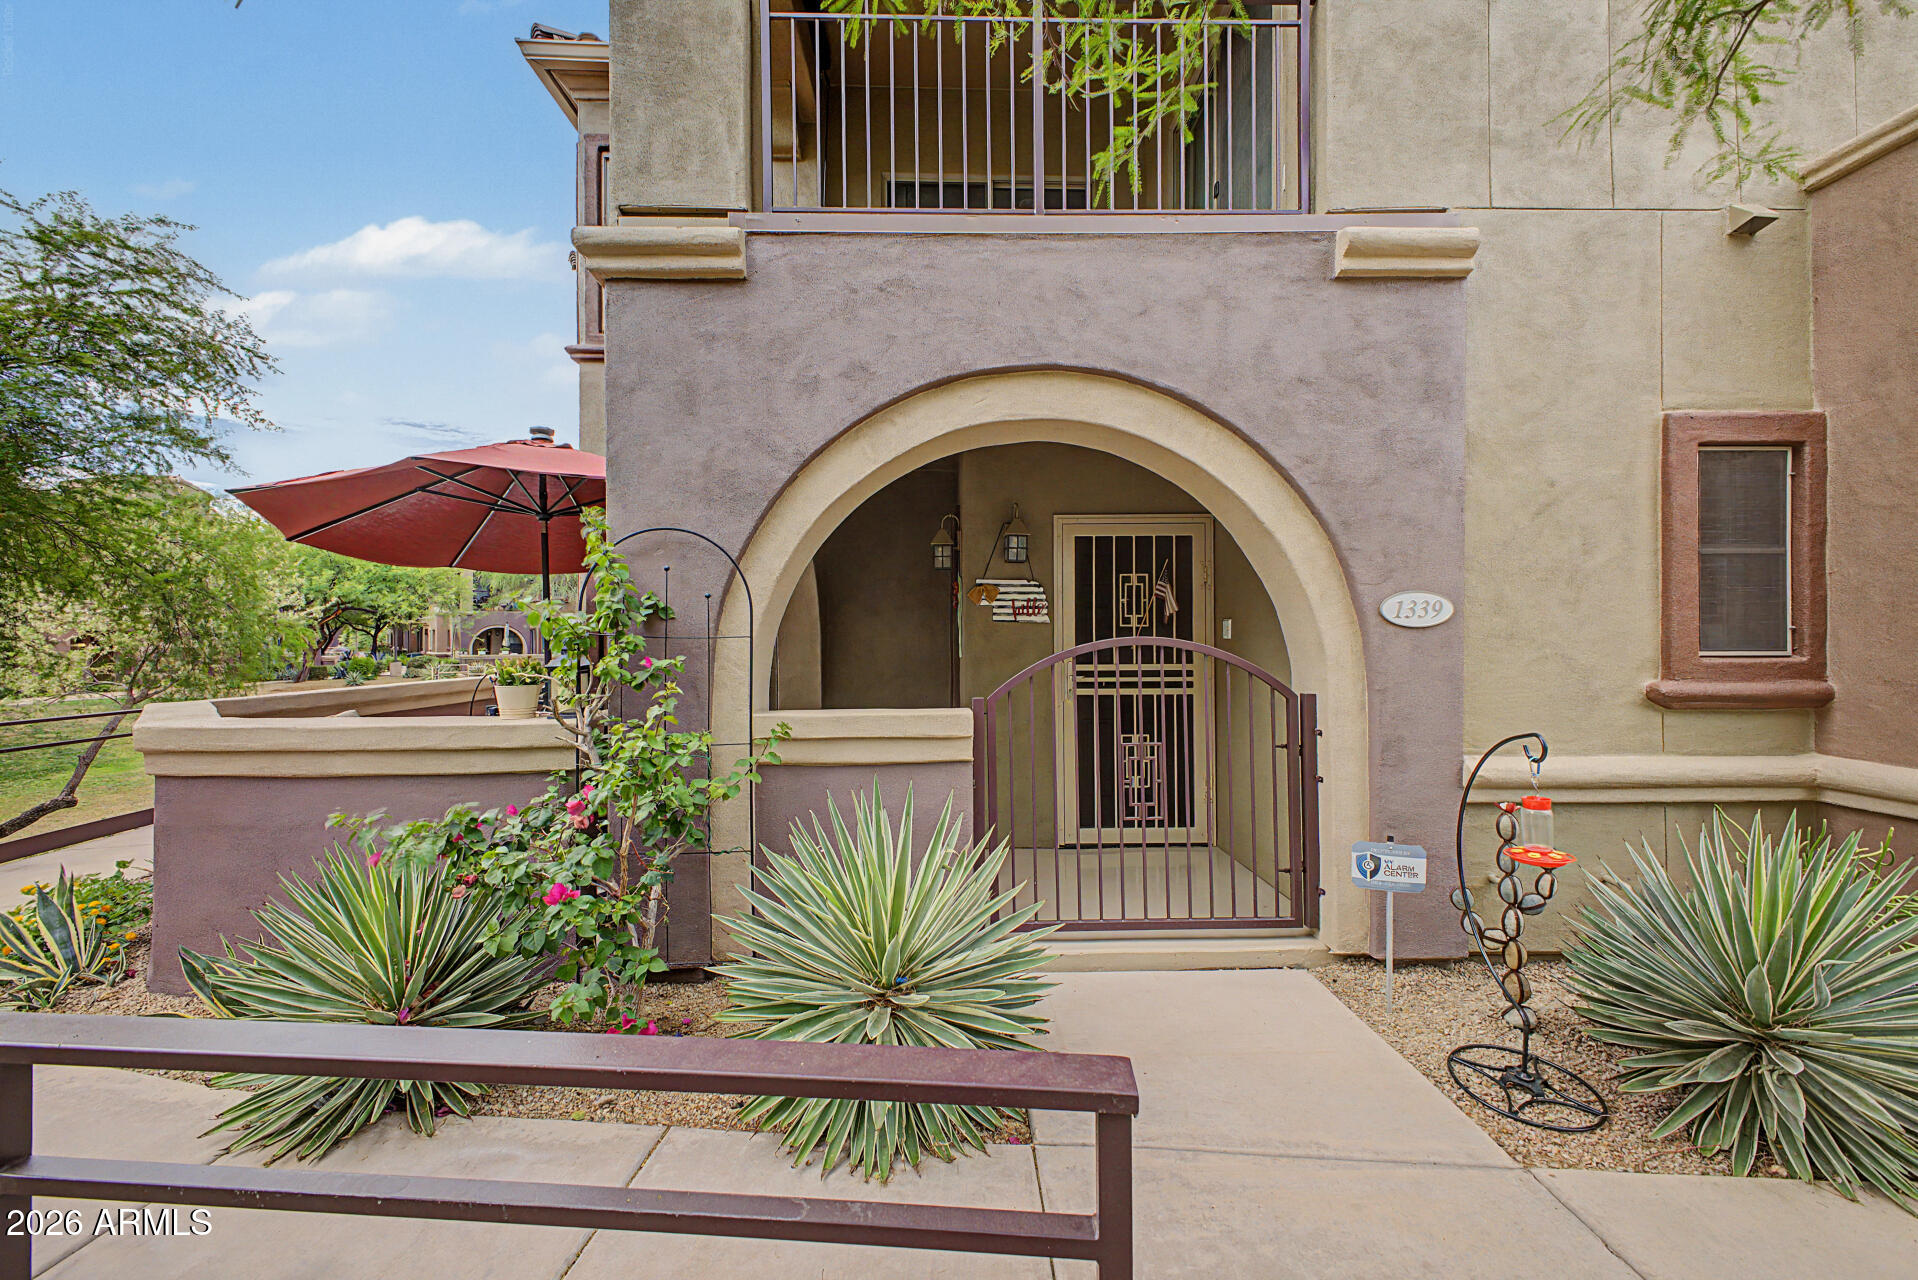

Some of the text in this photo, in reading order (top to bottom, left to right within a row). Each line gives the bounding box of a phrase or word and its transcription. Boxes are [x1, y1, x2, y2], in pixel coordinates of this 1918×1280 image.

[1392, 600, 1443, 619] 1339
[1383, 864, 1415, 872] ALARM
[1383, 870, 1419, 879] CENTER
